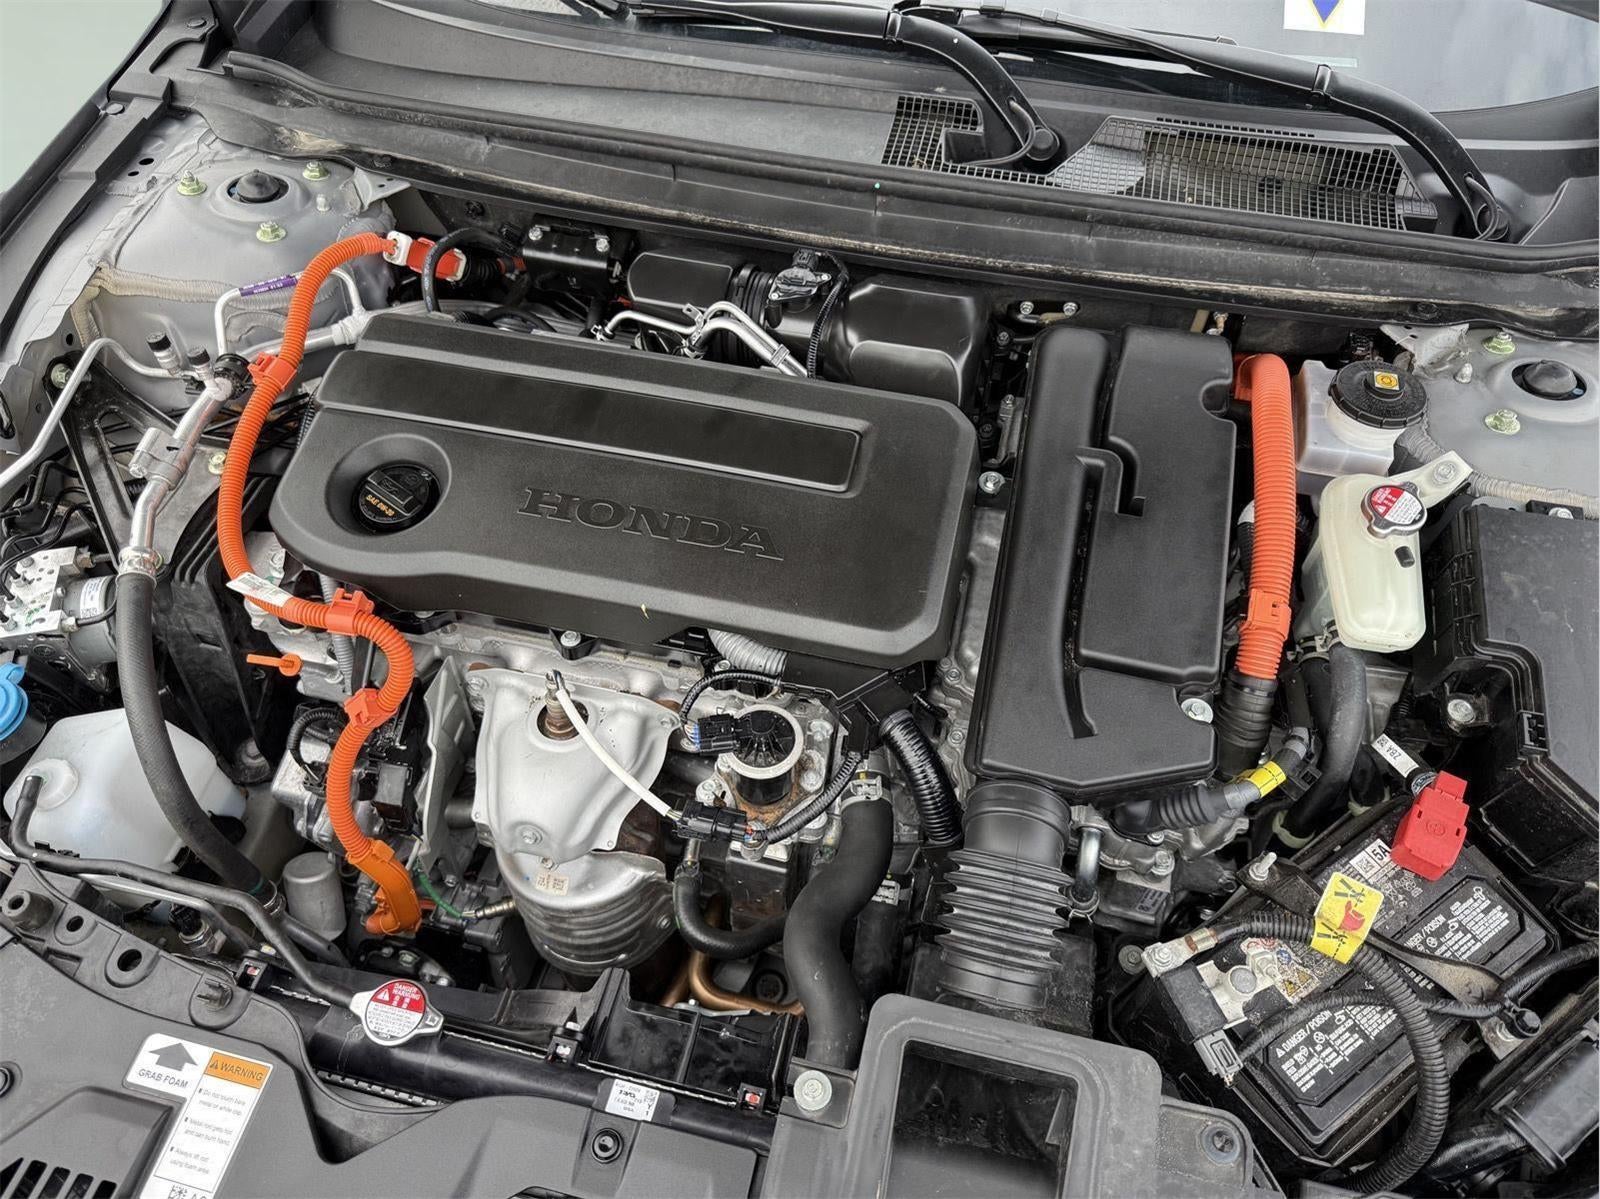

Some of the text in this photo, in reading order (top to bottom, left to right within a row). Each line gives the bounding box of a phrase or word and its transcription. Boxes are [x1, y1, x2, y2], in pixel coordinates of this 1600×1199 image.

[517, 487, 784, 561] HONDA
[1371, 844, 1391, 861] 5A
[138, 1068, 189, 1089] GRAB FOAM
[220, 1062, 264, 1081] WARNING
